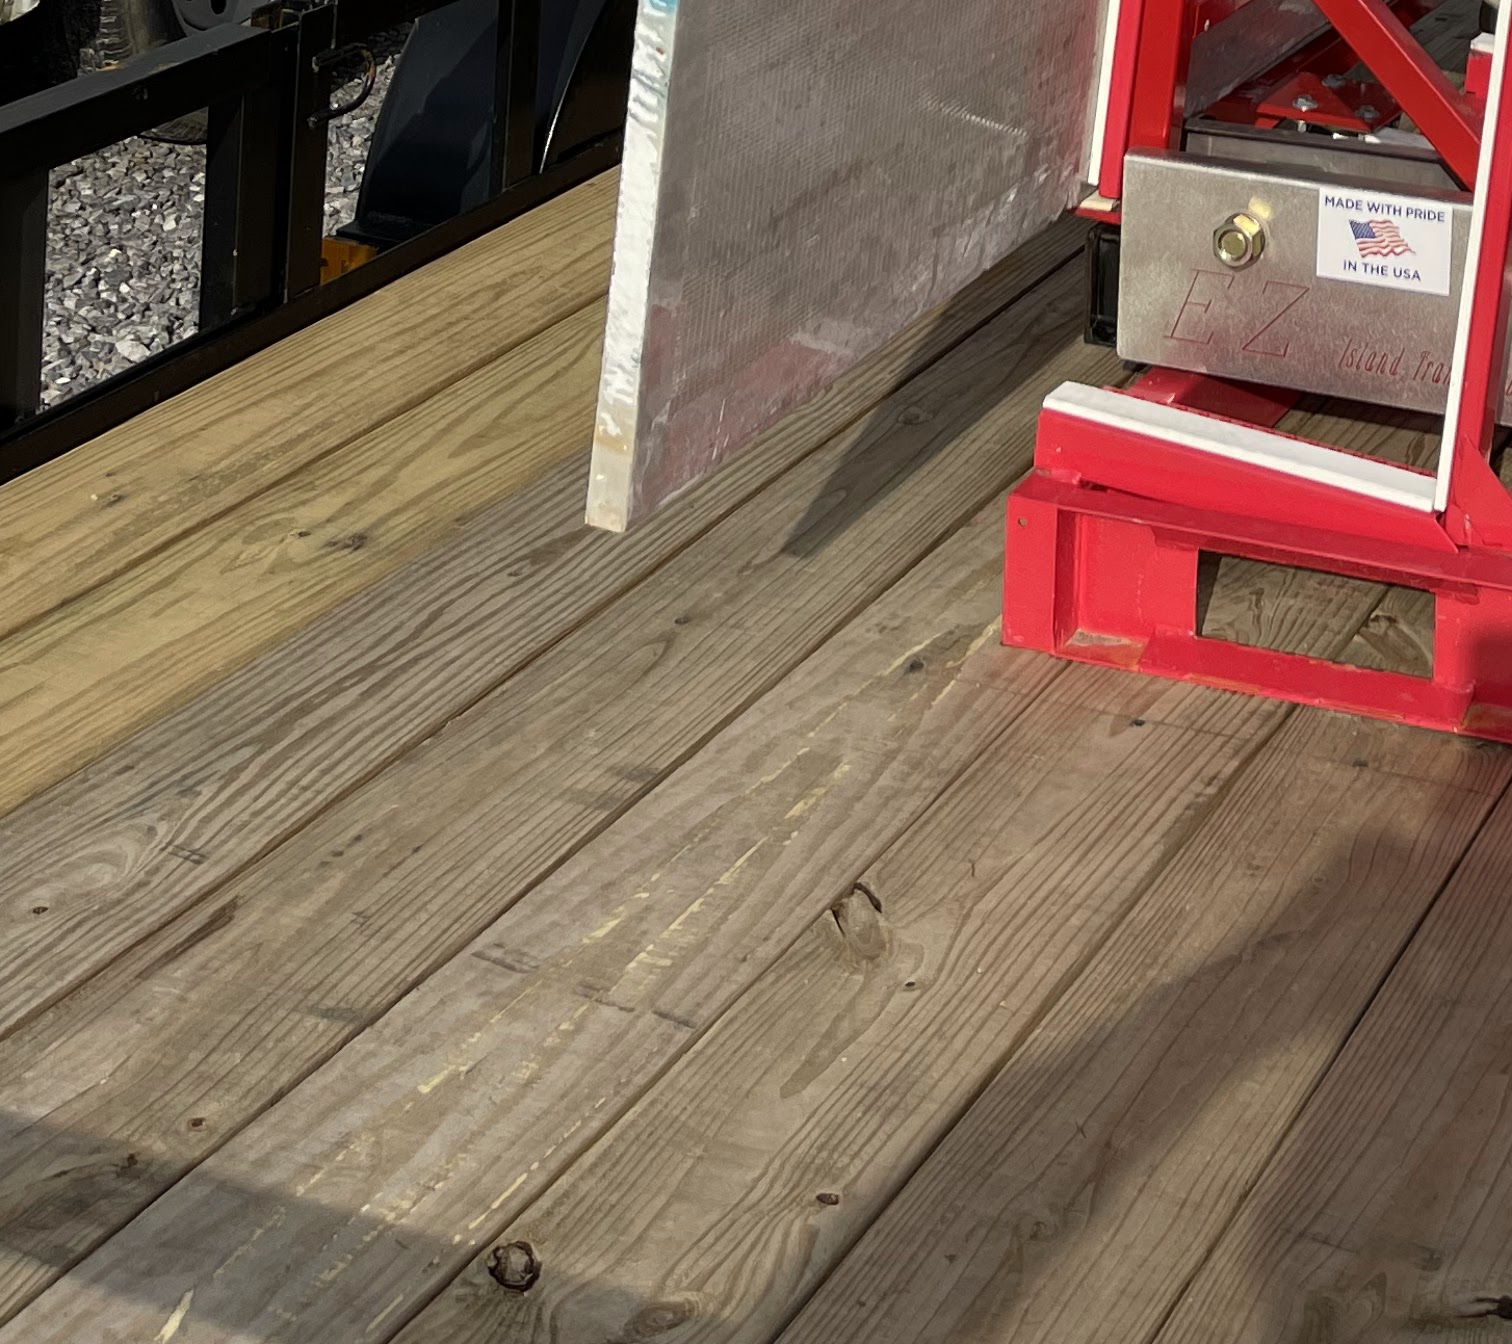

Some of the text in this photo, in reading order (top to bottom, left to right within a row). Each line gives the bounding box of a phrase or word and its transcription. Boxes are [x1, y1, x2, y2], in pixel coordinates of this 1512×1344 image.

[1324, 195, 1445, 223] MADE WITH PRIDE
[1343, 260, 1421, 282] IN THE USA
[1338, 339, 1405, 376] Island
